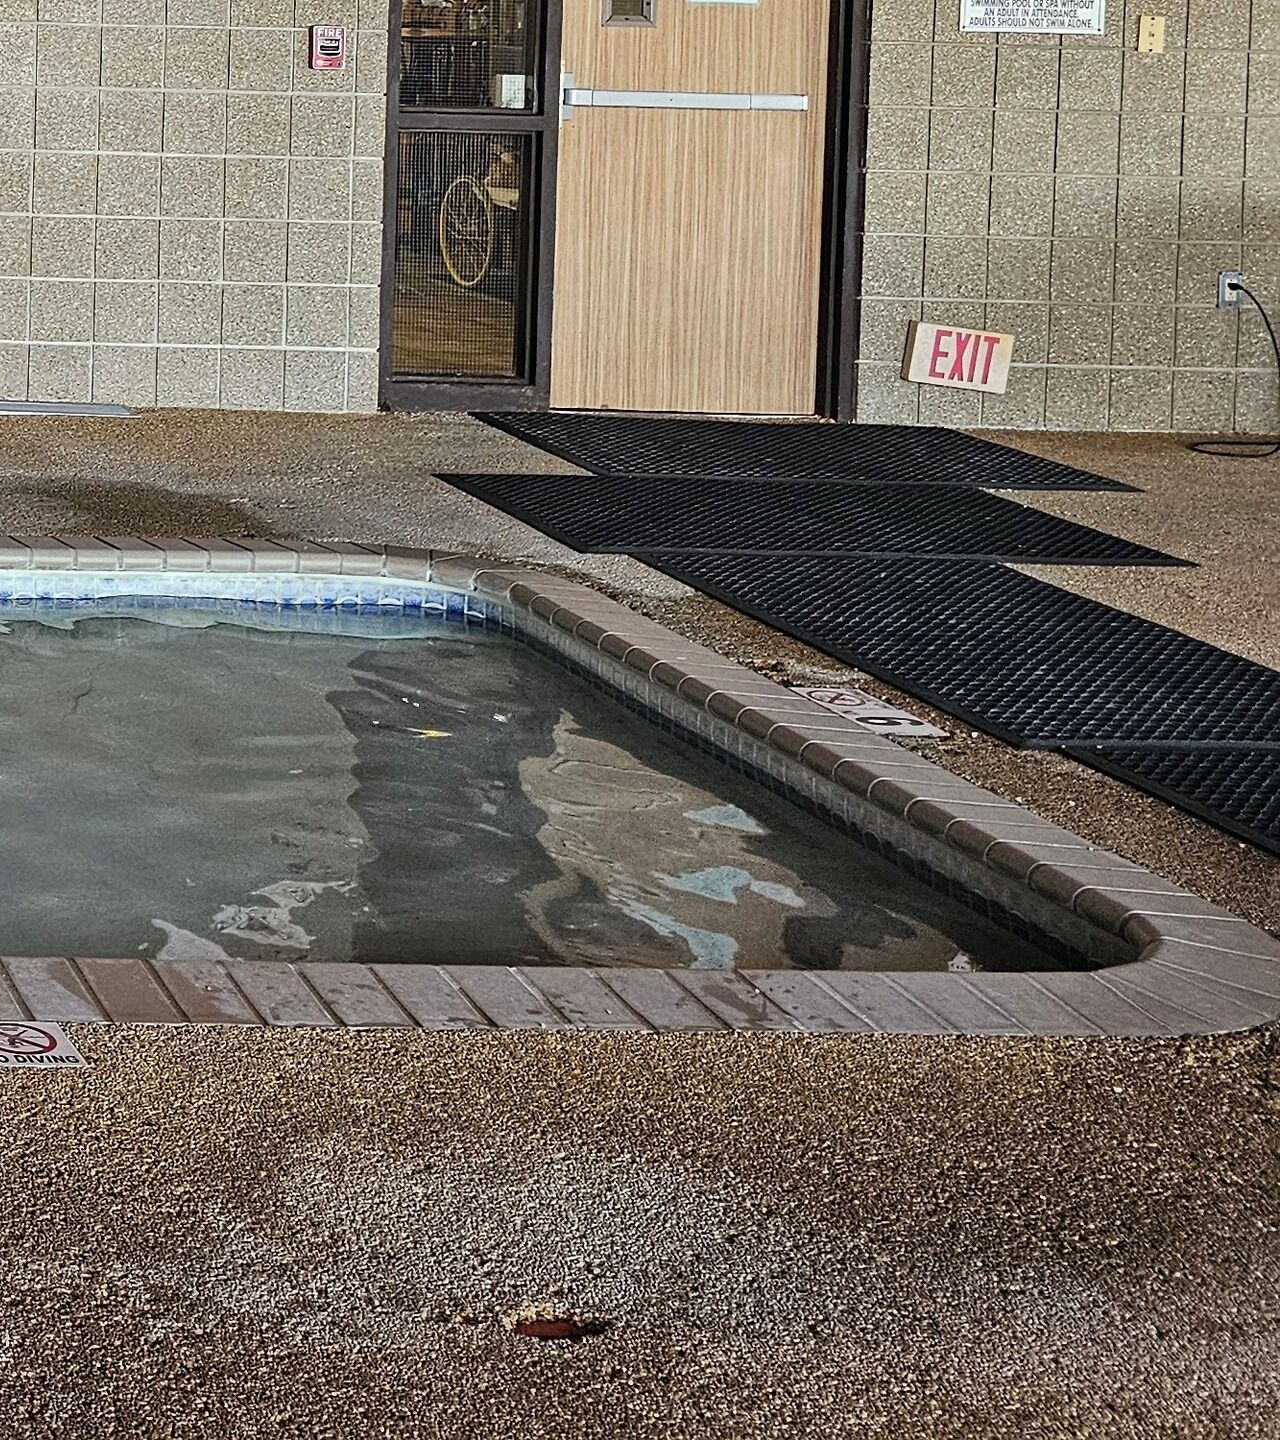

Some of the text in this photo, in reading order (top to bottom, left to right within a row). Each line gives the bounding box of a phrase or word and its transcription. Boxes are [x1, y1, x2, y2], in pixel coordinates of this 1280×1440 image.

[1012, 0, 1031, 8] POOL
[1033, 0, 1043, 8] OR
[1045, 0, 1058, 8] SPA
[1060, 0, 1094, 9] WITHOUT
[984, 8, 995, 17] AN
[996, 8, 1019, 17] ADULT
[1021, 9, 1029, 17] IN
[969, 17, 995, 26] ADULTS
[997, 18, 1026, 27] SHOULD
[1029, 19, 1044, 27] NOT
[1046, 19, 1065, 27] SWIM
[318, 28, 343, 37] FIRE
[928, 329, 1000, 385] EXIT
[13, 1055, 80, 1063] DIVING
